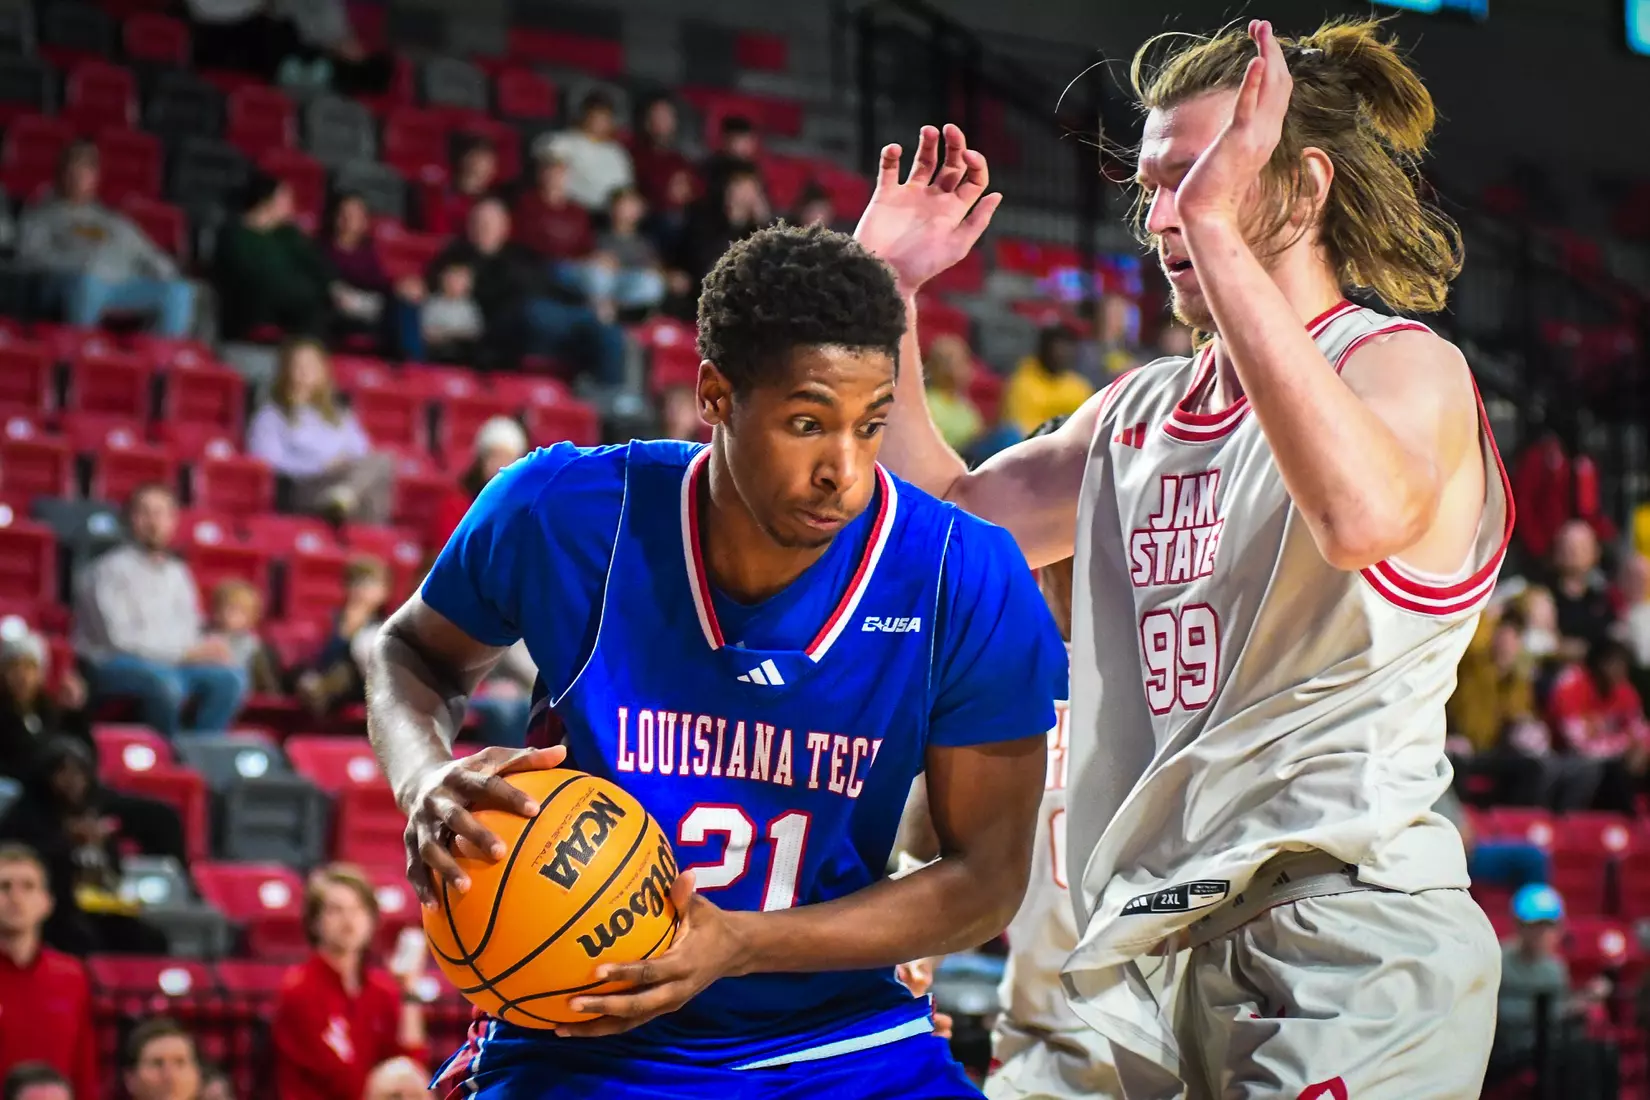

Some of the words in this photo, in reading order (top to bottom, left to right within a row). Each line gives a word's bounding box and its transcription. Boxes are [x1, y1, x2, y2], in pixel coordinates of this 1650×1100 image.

[1130, 518, 1225, 588] STATE
[1140, 602, 1220, 716] 99
[616, 707, 794, 787] LOUISIANA
[538, 791, 627, 890] NCAA
[676, 802, 813, 913] 21
[576, 833, 678, 957] Wilson
[1160, 893, 1181, 905] 2XL
